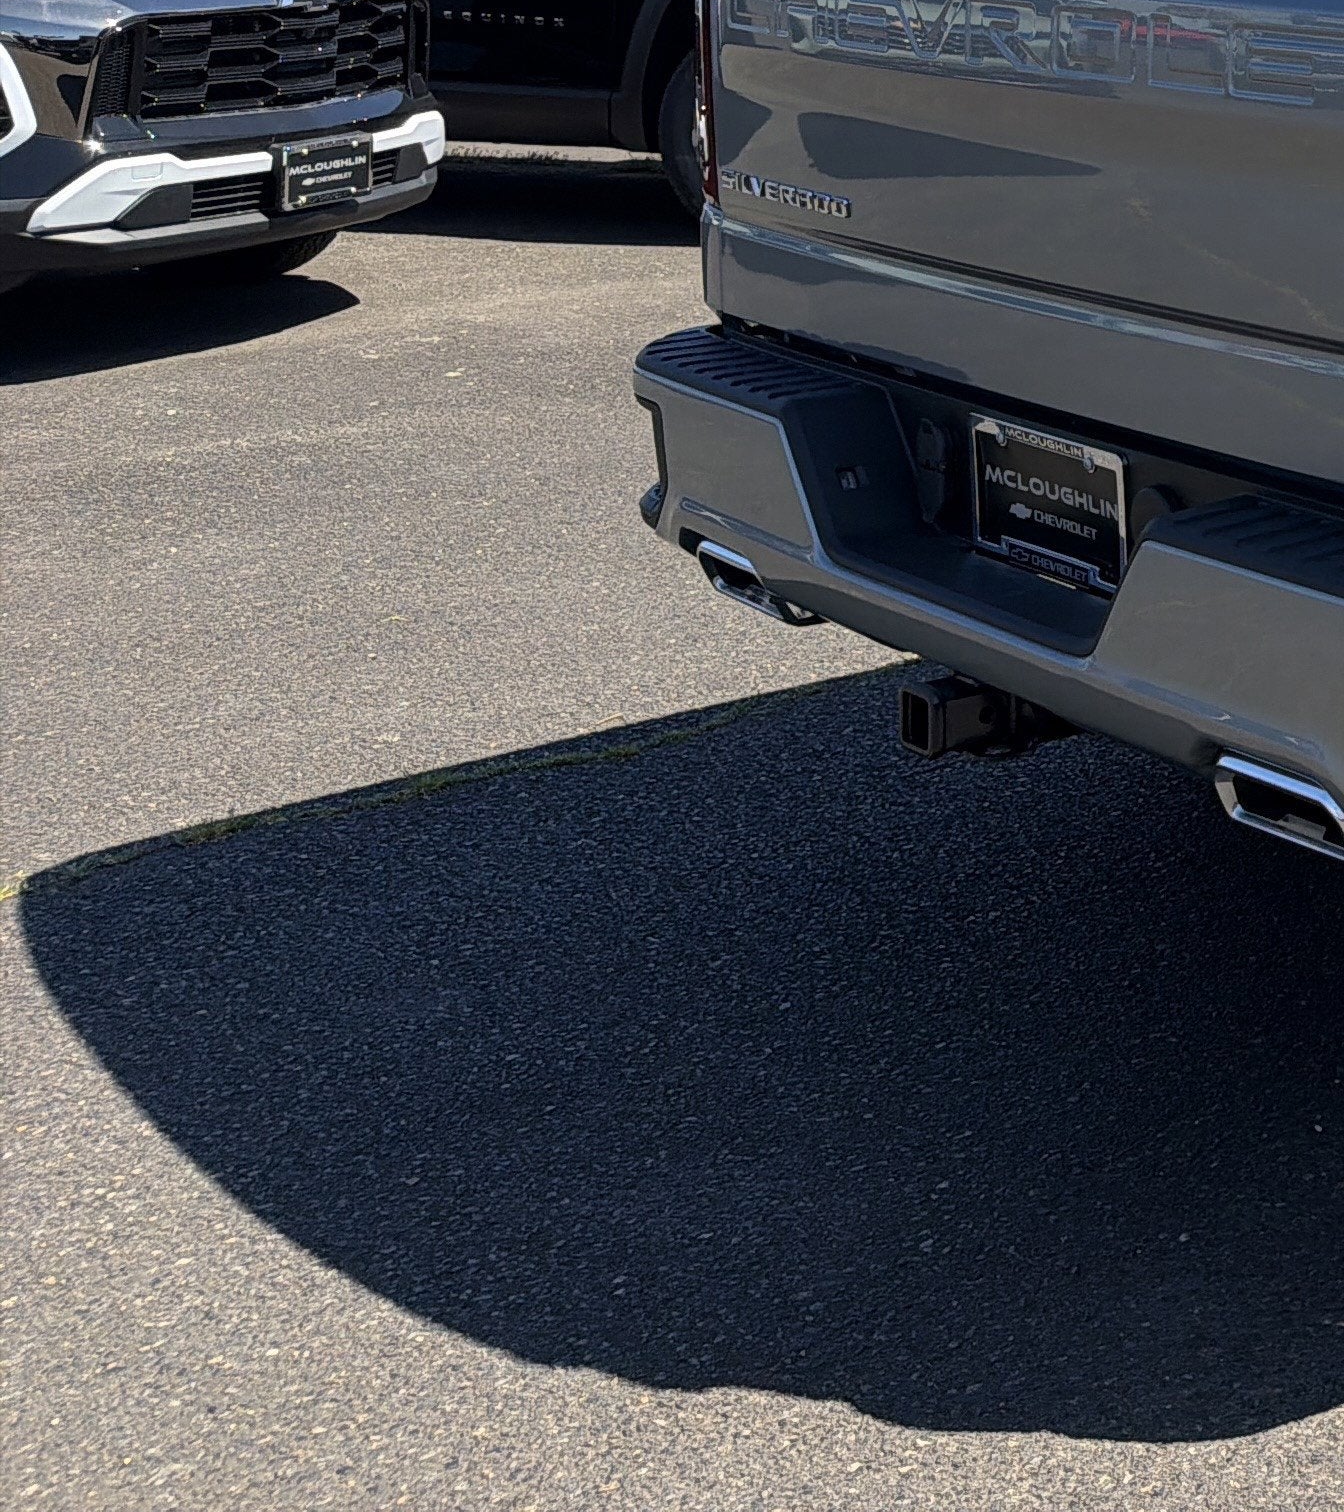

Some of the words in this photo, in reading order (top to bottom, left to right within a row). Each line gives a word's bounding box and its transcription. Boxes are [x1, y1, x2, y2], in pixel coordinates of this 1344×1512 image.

[443, 10, 566, 27] EQUINOX
[288, 155, 368, 177] MCLOUGHLIN
[721, 169, 852, 218] SILVERADO
[1005, 427, 1084, 458] MCLOUGHLIN
[985, 464, 1120, 522] MCLOUGHLIN
[1033, 509, 1099, 541] CHEVROLET
[1031, 554, 1089, 582] CHEVROLET
